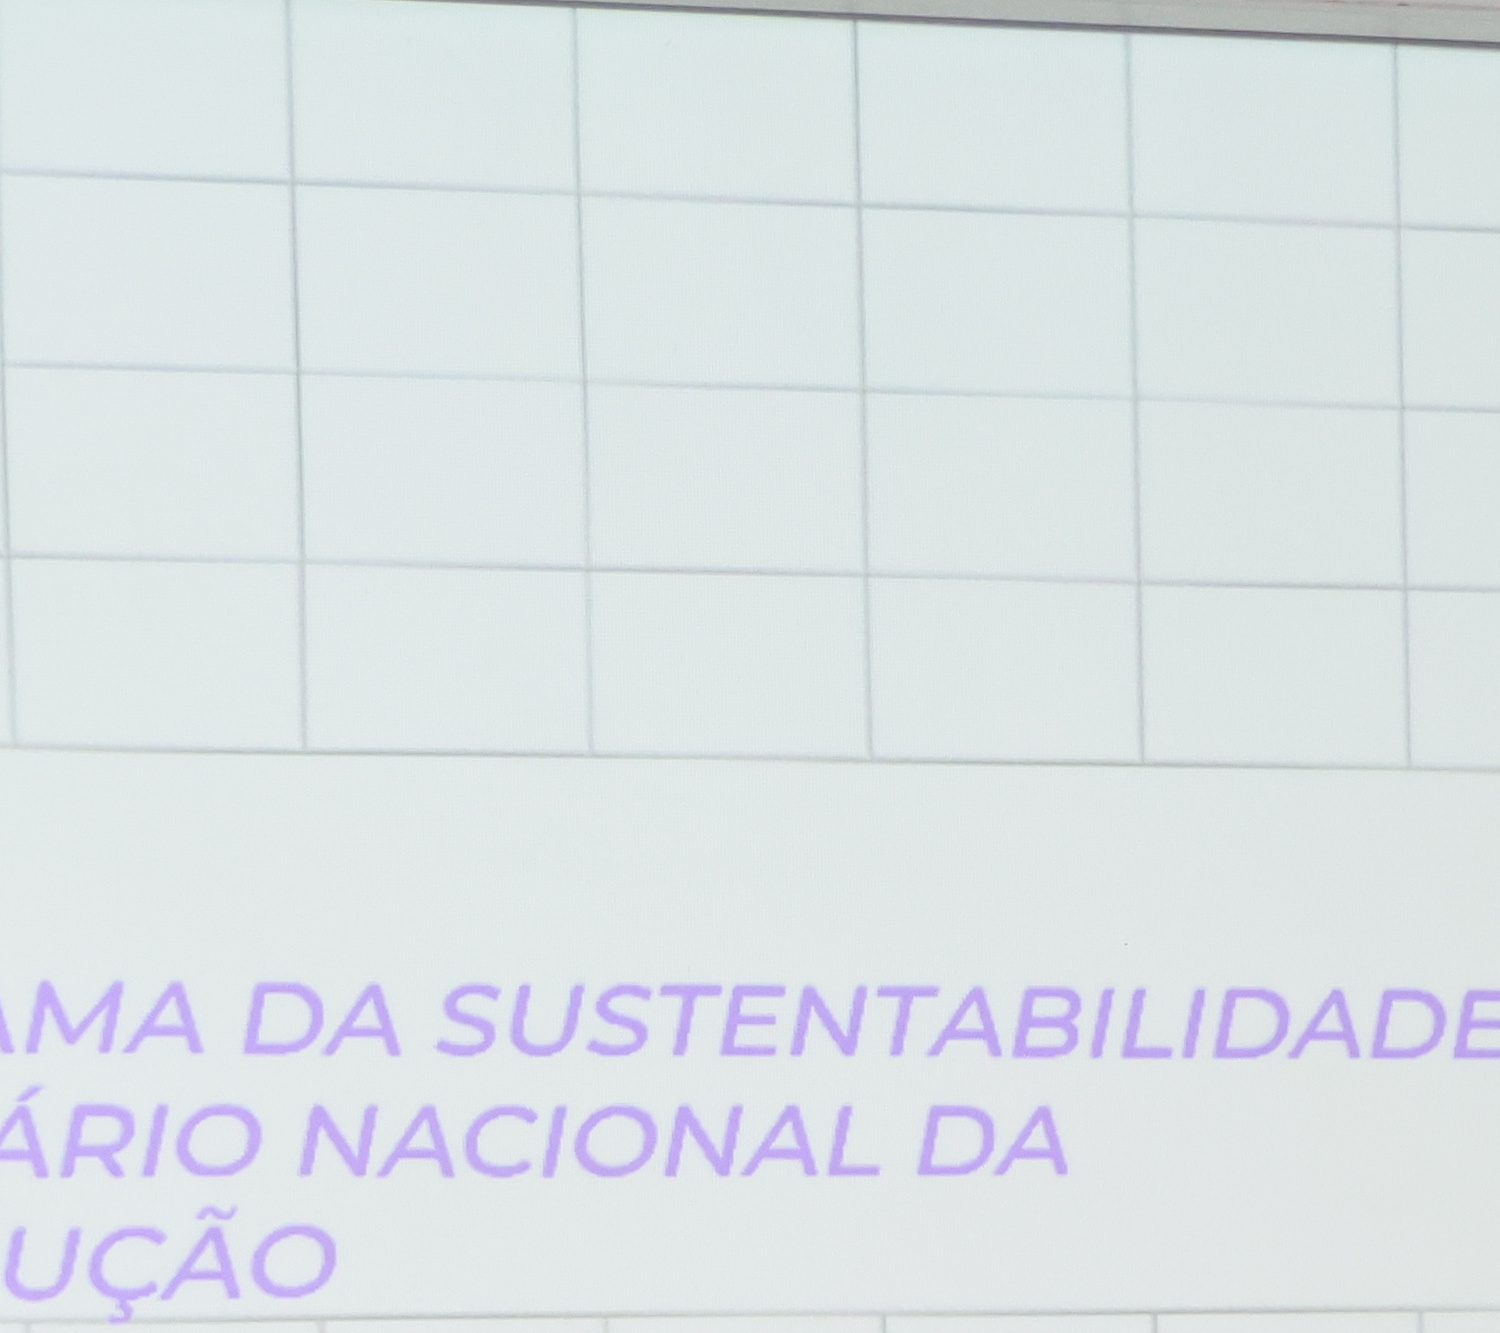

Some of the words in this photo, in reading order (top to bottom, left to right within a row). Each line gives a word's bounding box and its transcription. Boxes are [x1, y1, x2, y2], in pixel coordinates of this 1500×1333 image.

[242, 981, 402, 1057] DA
[298, 1103, 881, 1179] NACIONAL
[917, 1104, 1069, 1177] DA
